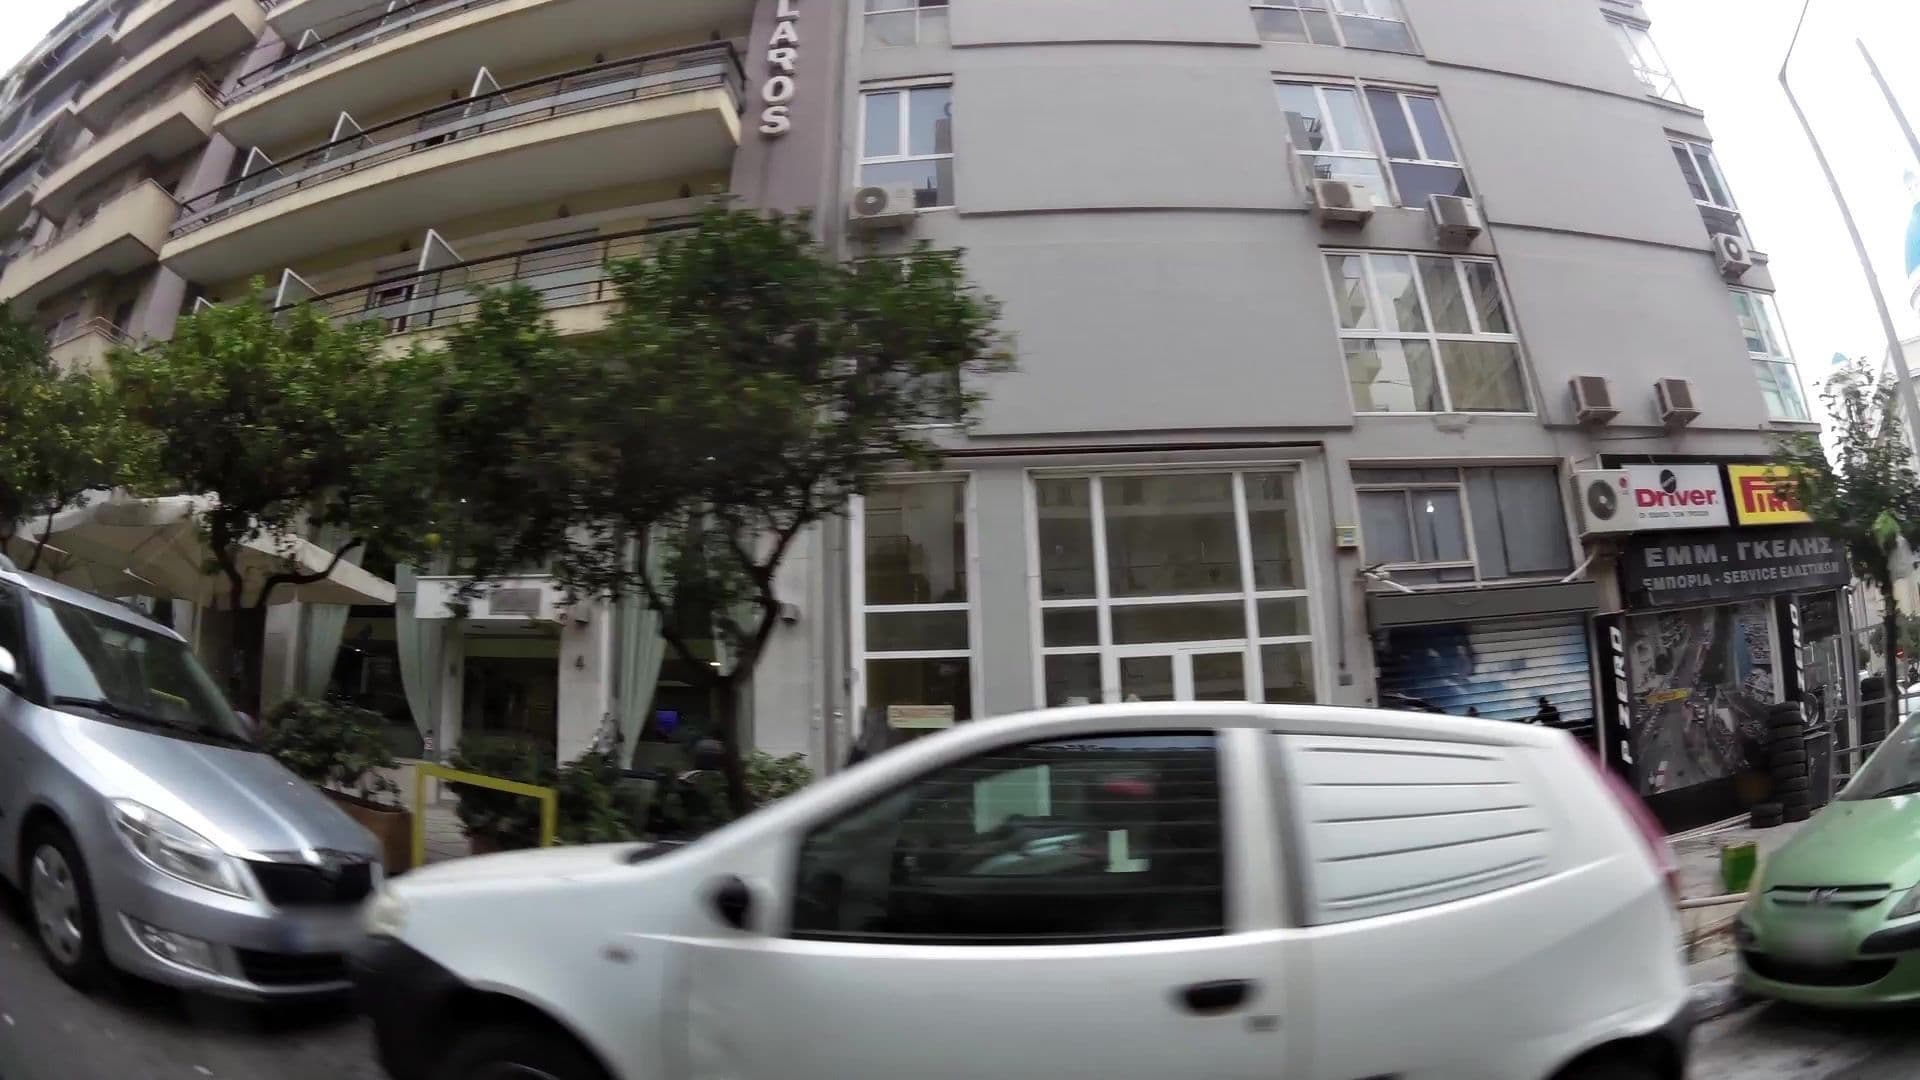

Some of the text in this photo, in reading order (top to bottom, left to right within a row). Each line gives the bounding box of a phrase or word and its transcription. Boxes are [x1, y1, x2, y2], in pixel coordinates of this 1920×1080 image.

[1634, 488, 1717, 508] Driver
[1739, 476, 1803, 513] PIR
[1644, 537, 1833, 567] ΕΜΜ. ΓΚΕΛΗΣ
[1642, 573, 1712, 591] ΕΜΠΟΡΙΑ
[1723, 567, 1777, 584] SERVICE
